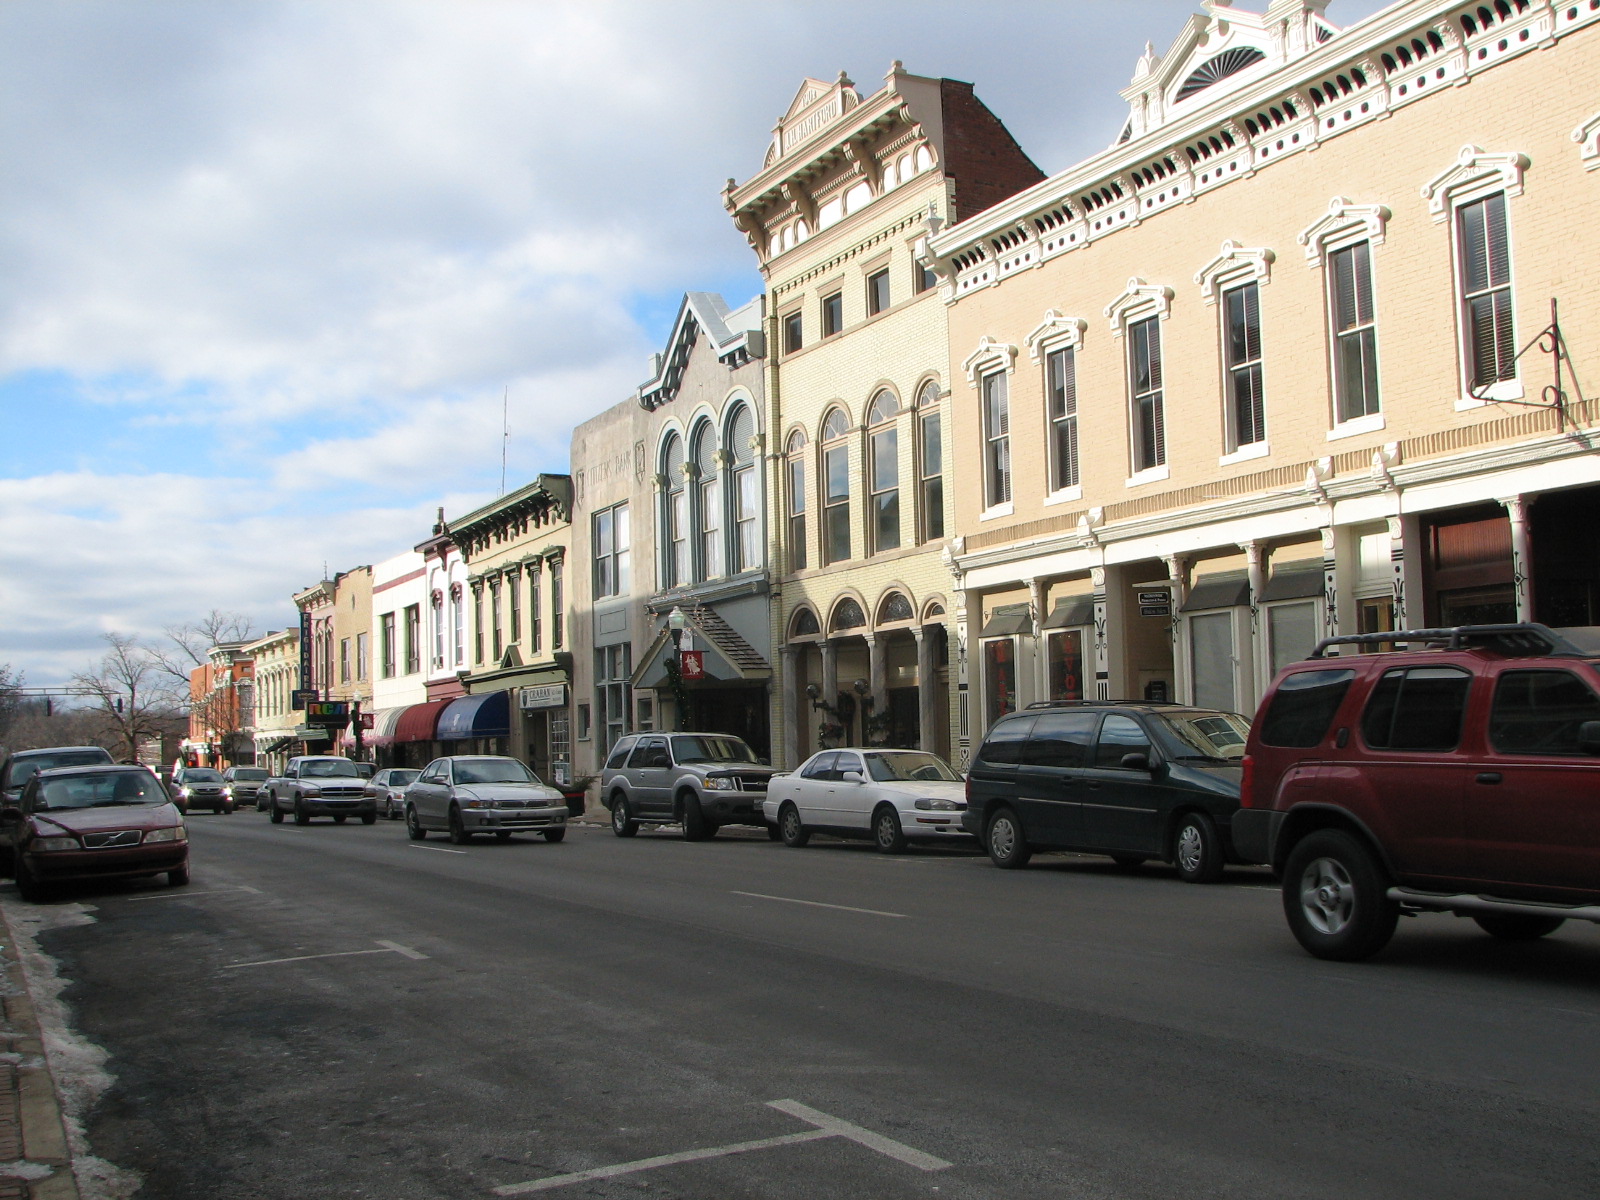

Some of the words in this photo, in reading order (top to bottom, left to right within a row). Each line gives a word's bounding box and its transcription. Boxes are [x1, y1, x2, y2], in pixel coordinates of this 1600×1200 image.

[798, 100, 837, 141] HARTFORD
[615, 449, 632, 475] BANK
[308, 703, 346, 715] RCA
